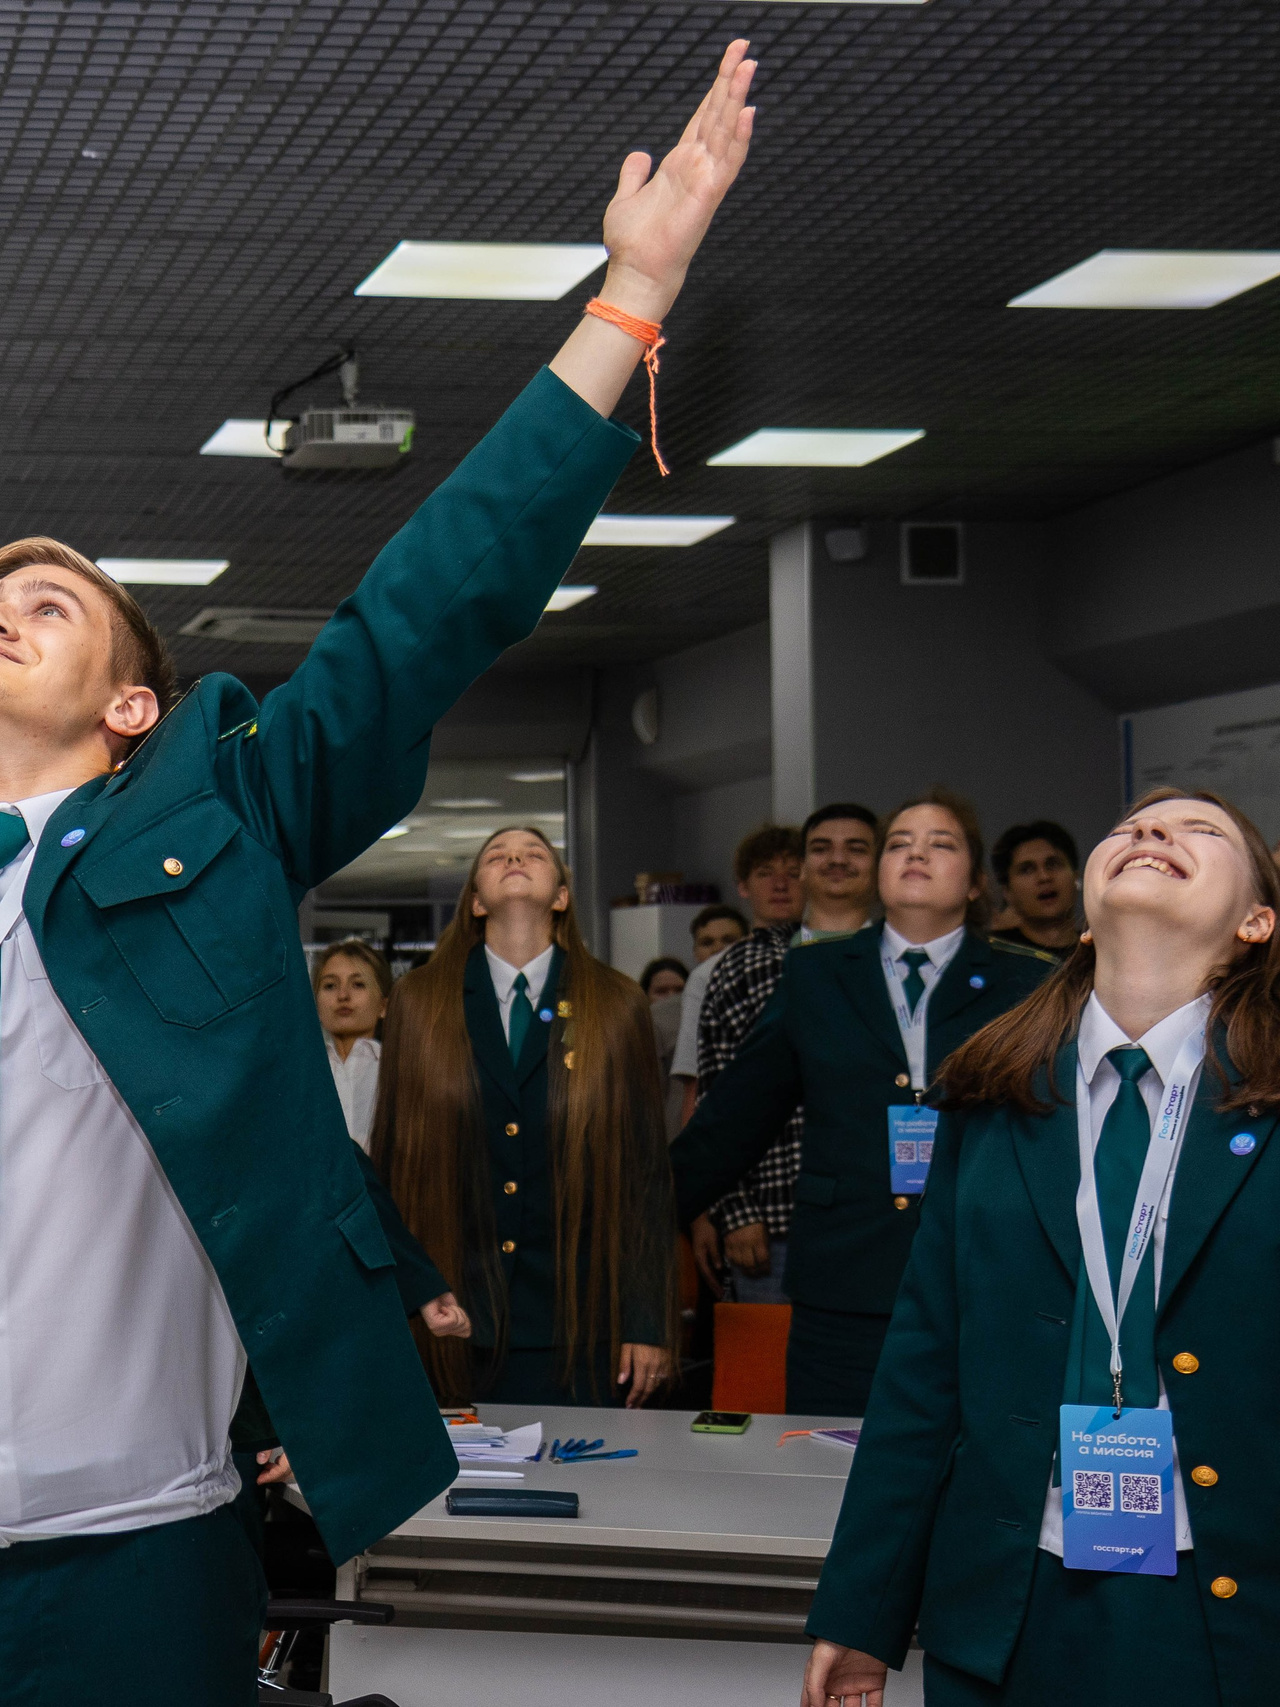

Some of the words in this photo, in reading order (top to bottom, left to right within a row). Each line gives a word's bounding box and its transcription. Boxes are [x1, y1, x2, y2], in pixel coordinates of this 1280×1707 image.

[1071, 1431, 1093, 1443] Не
[1096, 1433, 1161, 1449] работа,
[1078, 1446, 1090, 1455] а
[1093, 1447, 1154, 1458] миссия
[1093, 1544, 1144, 1556] госстарт.рф
